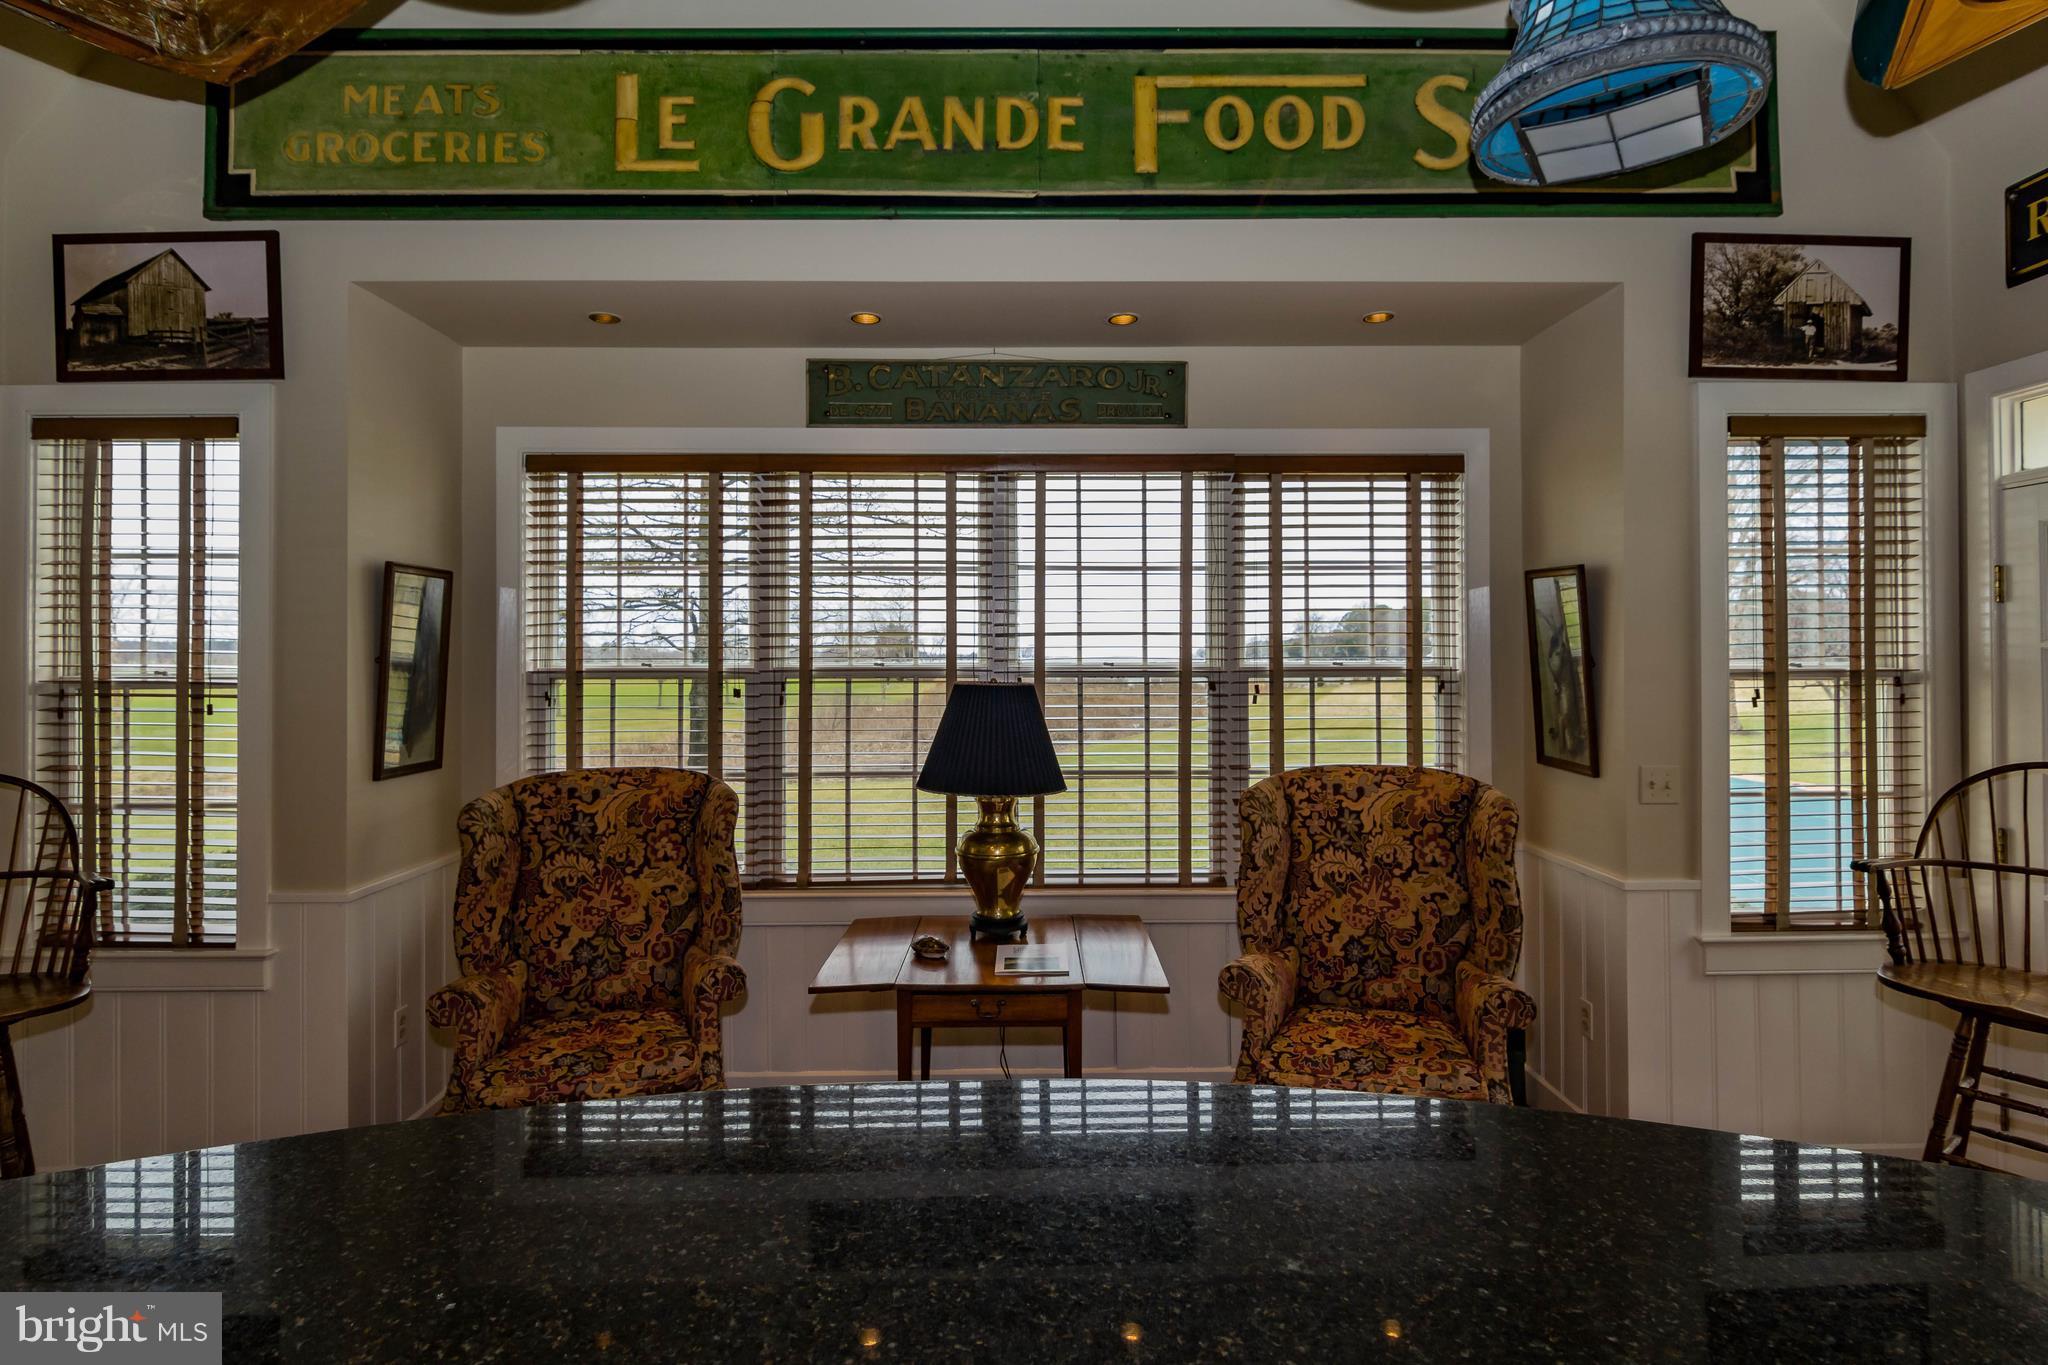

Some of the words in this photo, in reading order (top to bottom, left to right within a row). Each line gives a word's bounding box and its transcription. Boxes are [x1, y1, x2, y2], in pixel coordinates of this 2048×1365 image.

[342, 82, 502, 118] MEATS
[615, 72, 700, 173] LE
[747, 76, 1085, 174] GRANDE
[1134, 73, 1367, 174] FOOD
[282, 130, 548, 166] GROCERIES
[867, 363, 1126, 391] CATANZARO
[904, 397, 1083, 424] BANANAS
